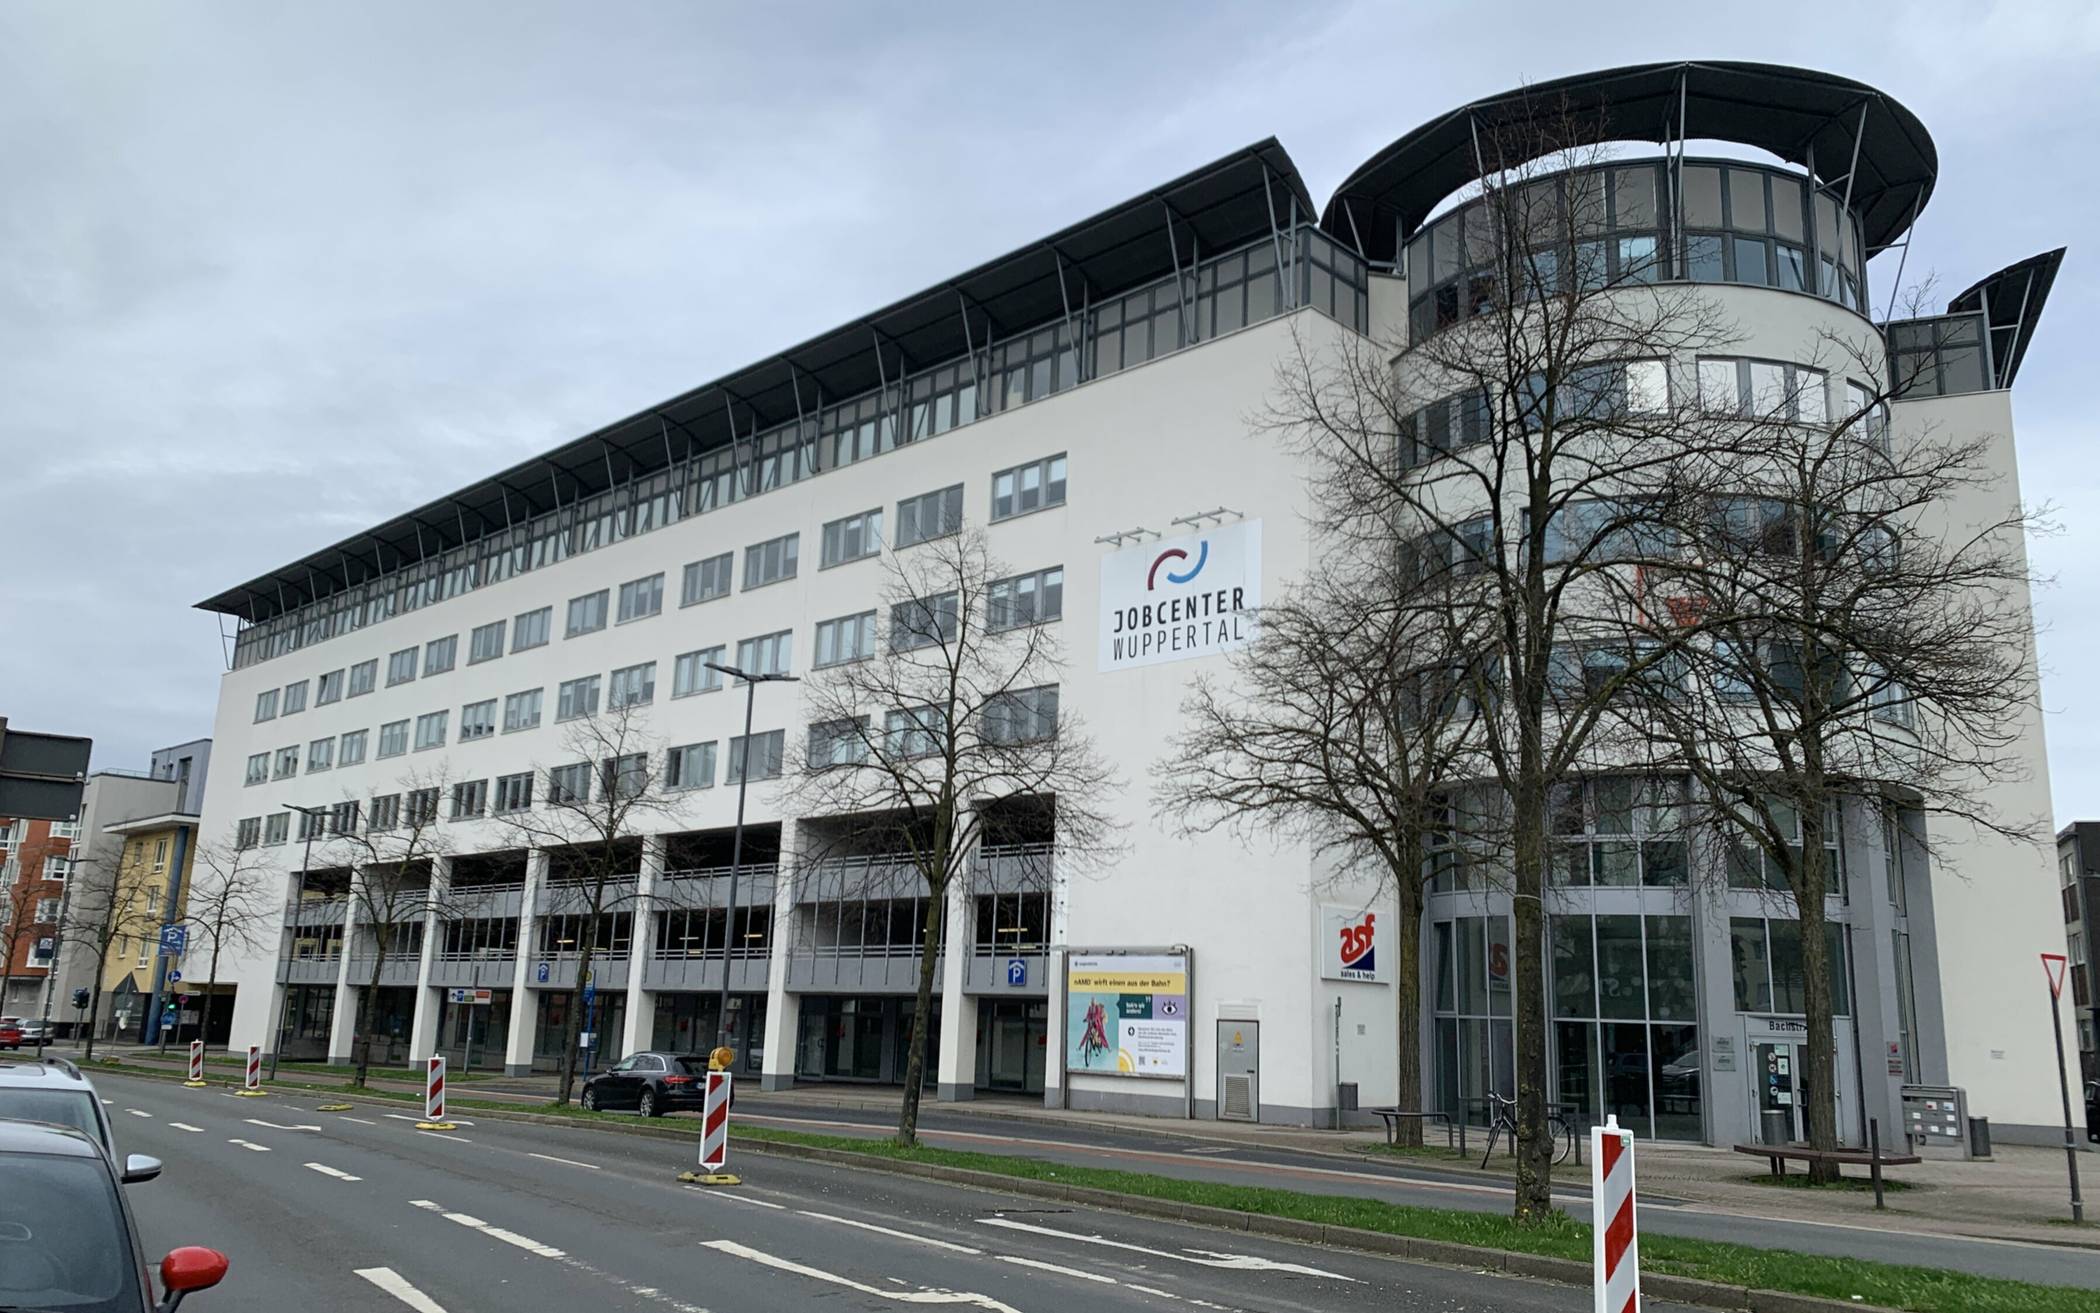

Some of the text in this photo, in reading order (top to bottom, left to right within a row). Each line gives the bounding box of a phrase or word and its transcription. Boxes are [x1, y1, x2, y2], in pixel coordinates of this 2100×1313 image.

[1113, 587, 1244, 633] JOBCENTER
[1113, 616, 1244, 661] WUPPERTAL
[1340, 913, 1375, 964] asf
[1013, 967, 1021, 983] P
[1139, 979, 1149, 987] der
[1151, 979, 1171, 988] Bahn?
[1362, 971, 1375, 981] help
